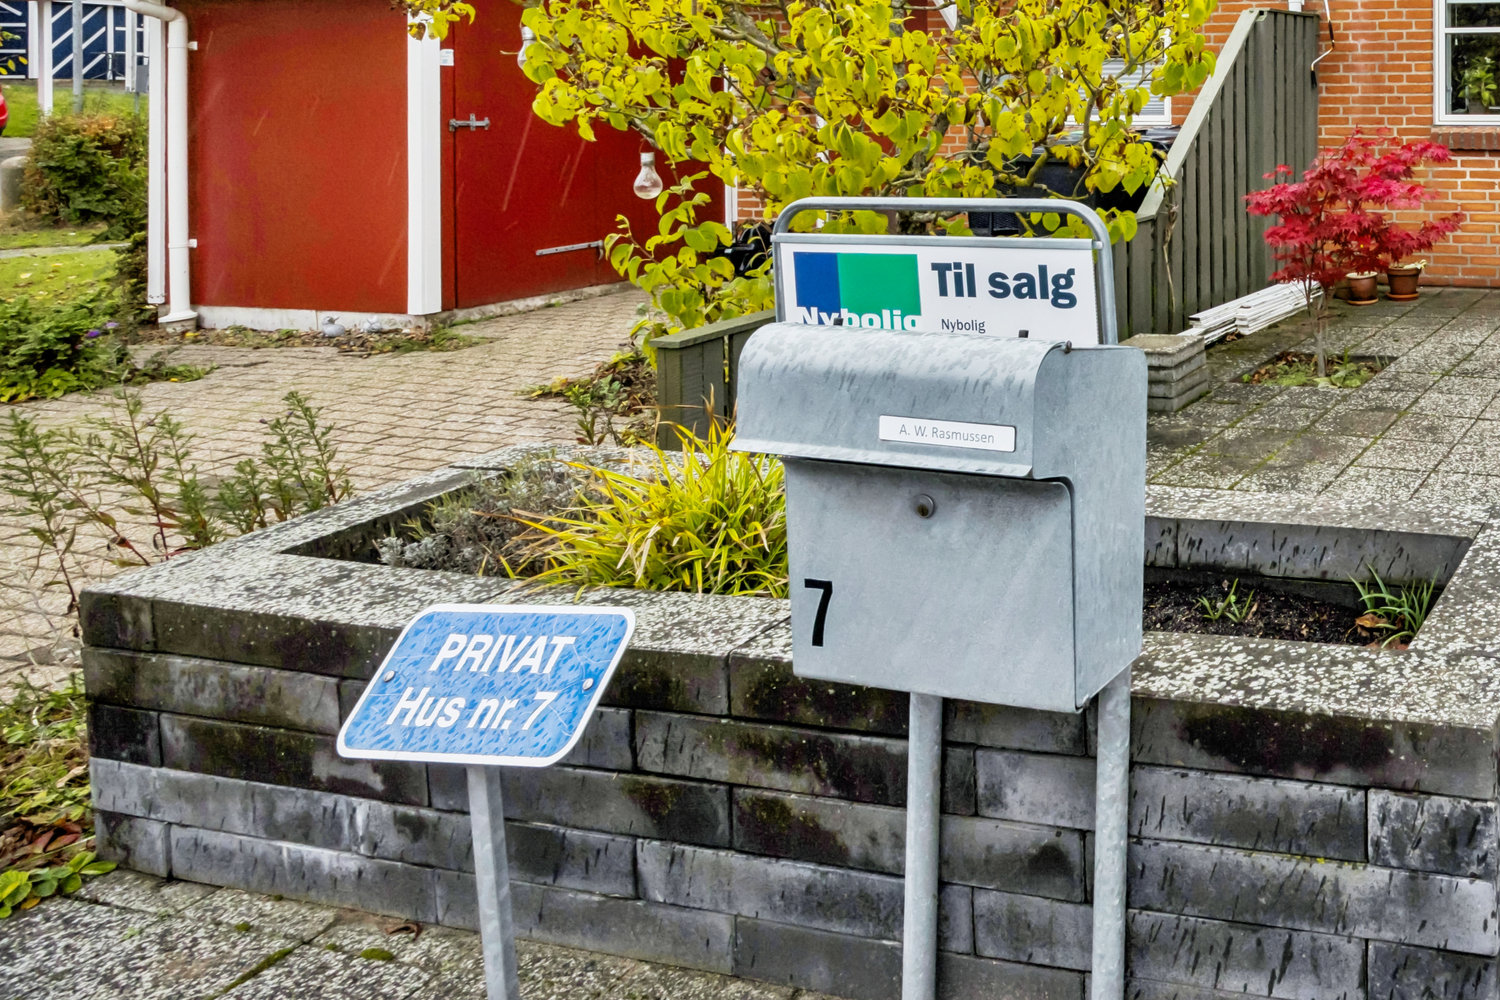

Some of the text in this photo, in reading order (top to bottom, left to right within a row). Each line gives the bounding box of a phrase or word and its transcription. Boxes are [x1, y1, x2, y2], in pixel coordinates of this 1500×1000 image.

[930, 261, 1078, 309] Til salg
[941, 318, 986, 334] Nybolig
[899, 424, 995, 444] A. W. Rasmussen
[804, 578, 833, 647] 7
[428, 633, 577, 674] PRIVAT
[385, 686, 559, 731] Hus nr. 7
